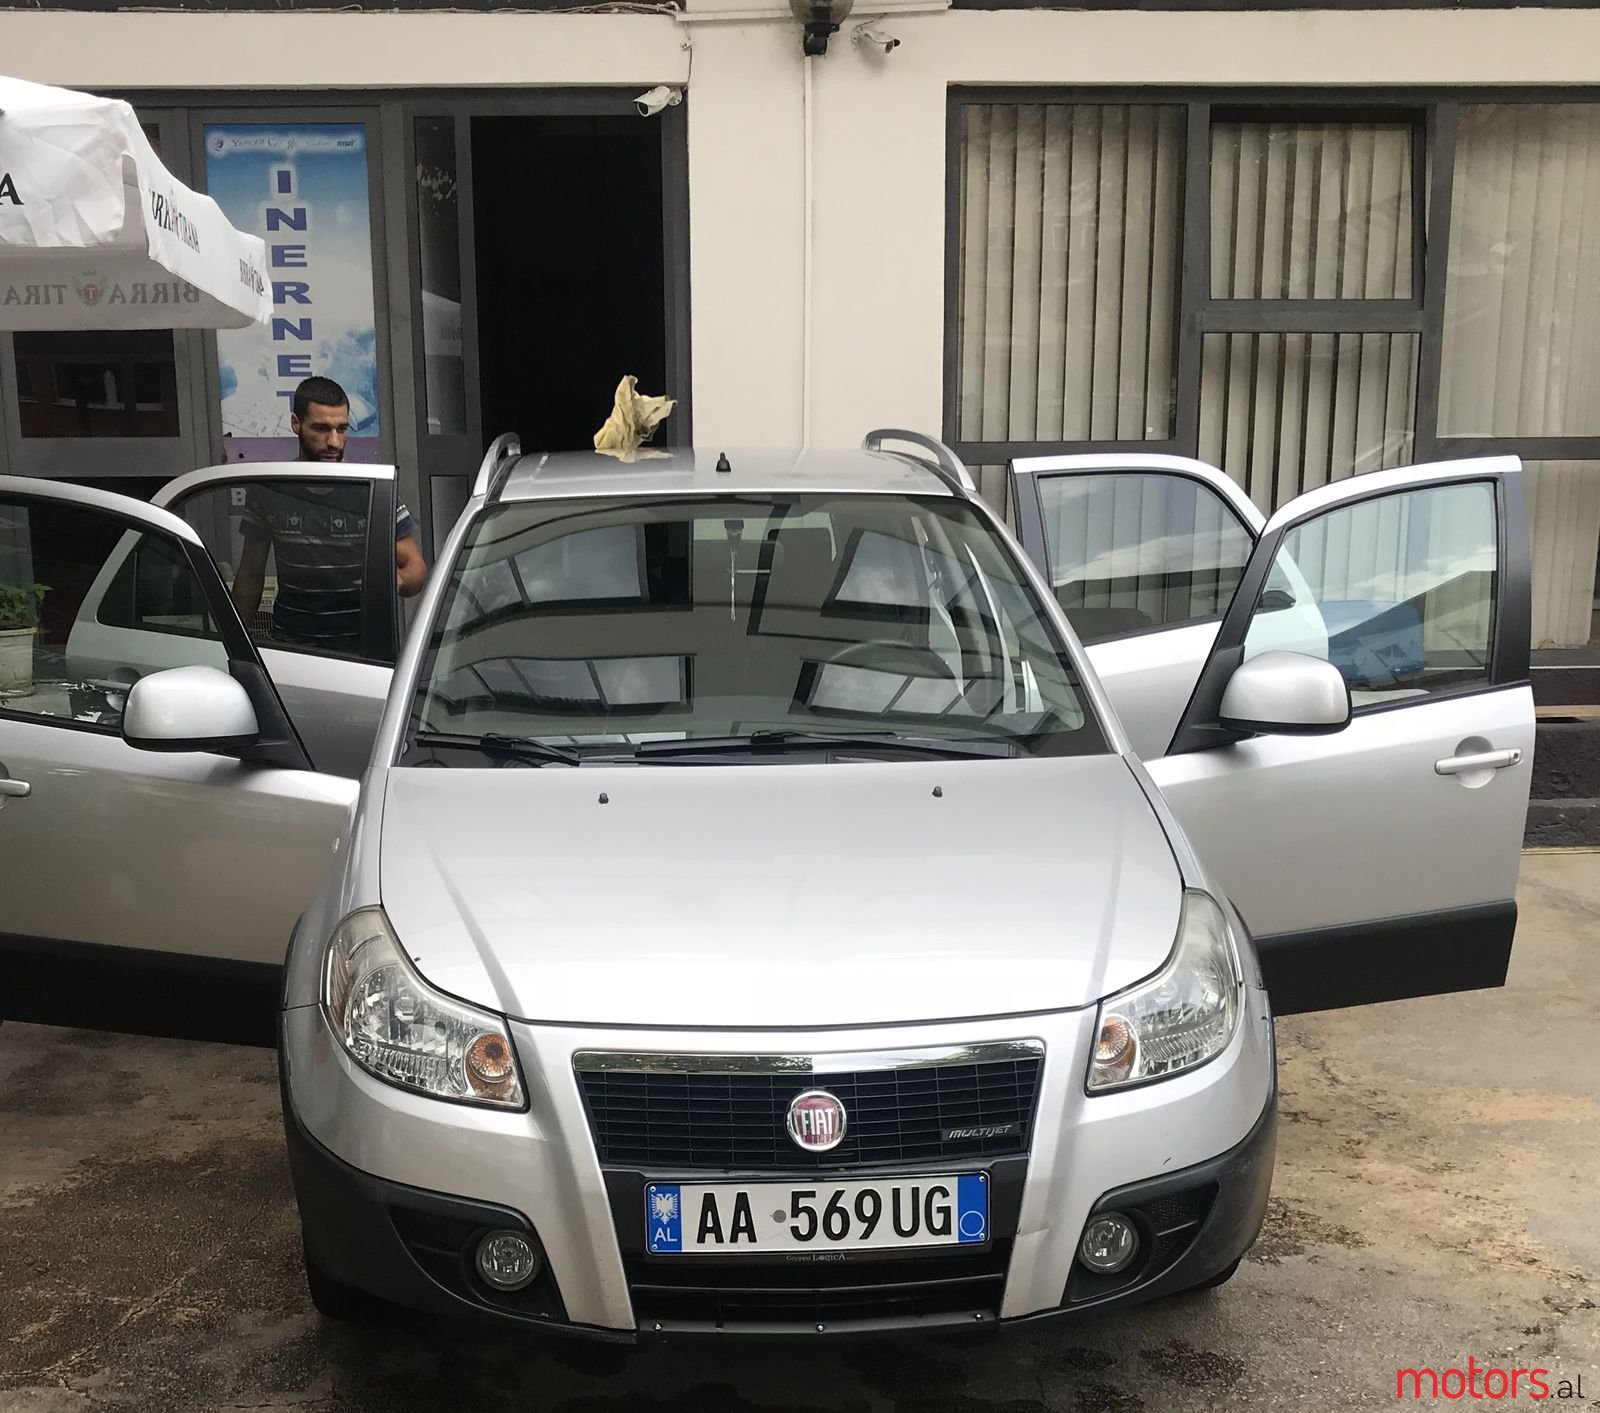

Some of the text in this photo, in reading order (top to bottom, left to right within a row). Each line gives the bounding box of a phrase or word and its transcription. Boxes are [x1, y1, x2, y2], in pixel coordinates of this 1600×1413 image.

[800, 1108, 835, 1136] FIAT
[696, 1192, 758, 1244] AA
[654, 1227, 678, 1242] AL
